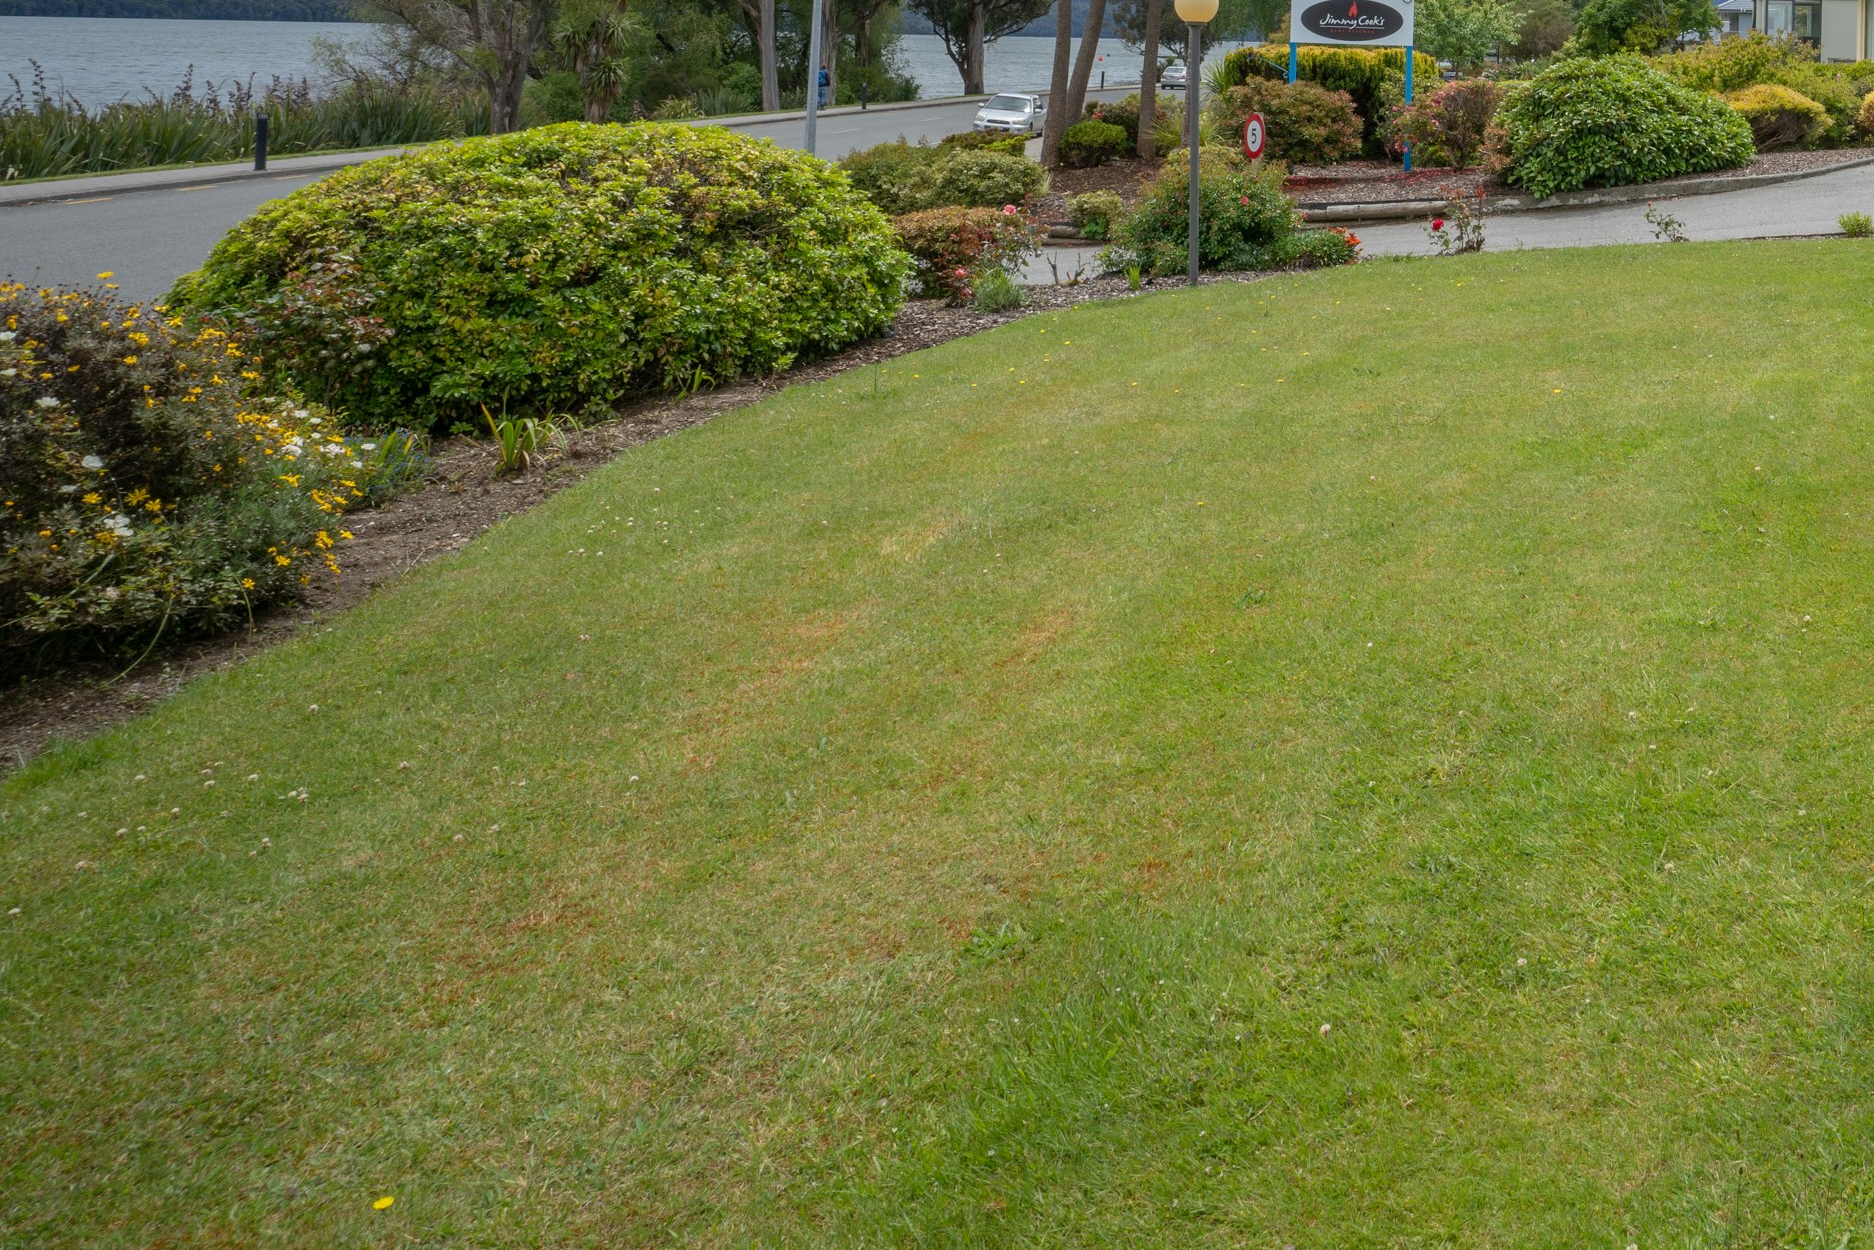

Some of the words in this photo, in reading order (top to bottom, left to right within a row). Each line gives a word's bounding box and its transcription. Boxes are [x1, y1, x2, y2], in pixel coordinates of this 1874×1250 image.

[1319, 13, 1357, 30] Jimmy
[1358, 15, 1385, 26] Cook's
[1251, 128, 1257, 144] 5
